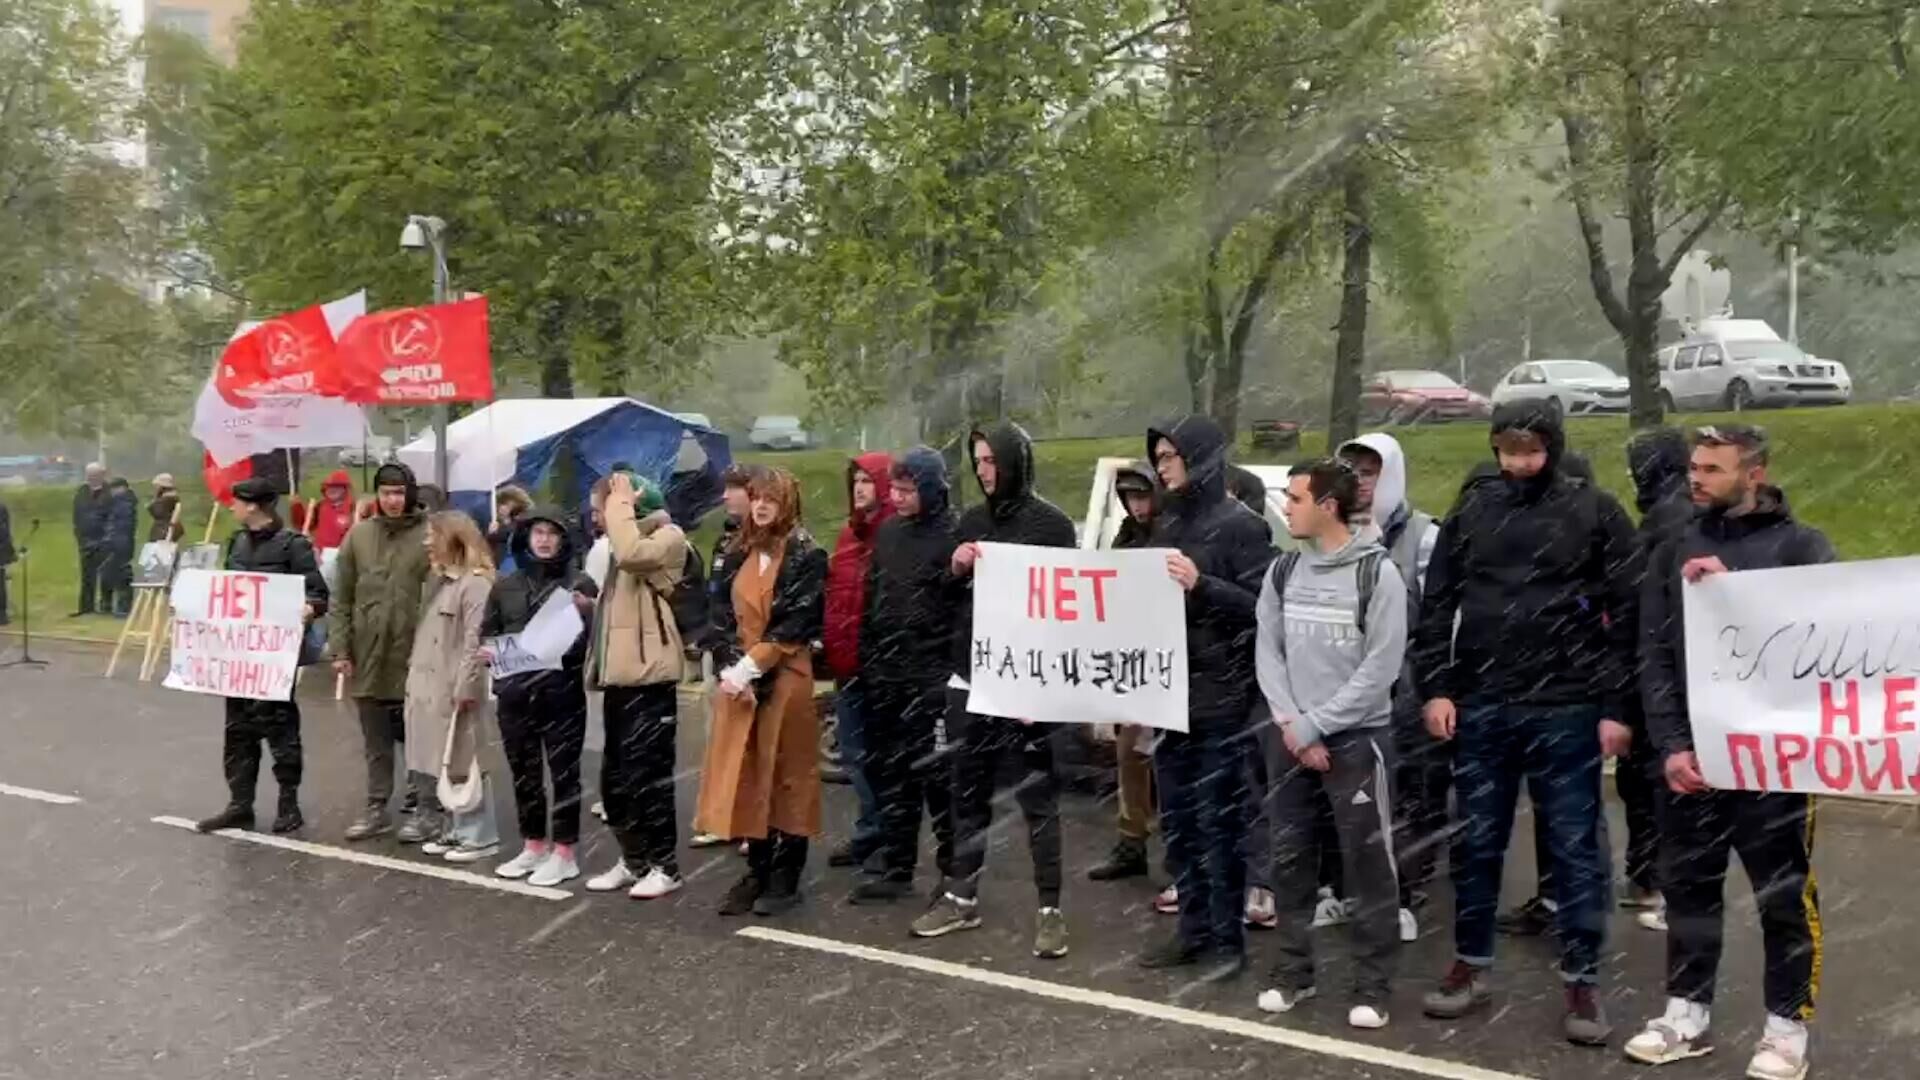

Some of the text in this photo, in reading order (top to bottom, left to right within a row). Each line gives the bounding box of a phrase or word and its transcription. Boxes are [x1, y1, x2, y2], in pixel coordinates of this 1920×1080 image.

[208, 575, 269, 619] НЕТ
[1027, 566, 1117, 622] НЕТ
[1819, 677, 1916, 735] НЕ
